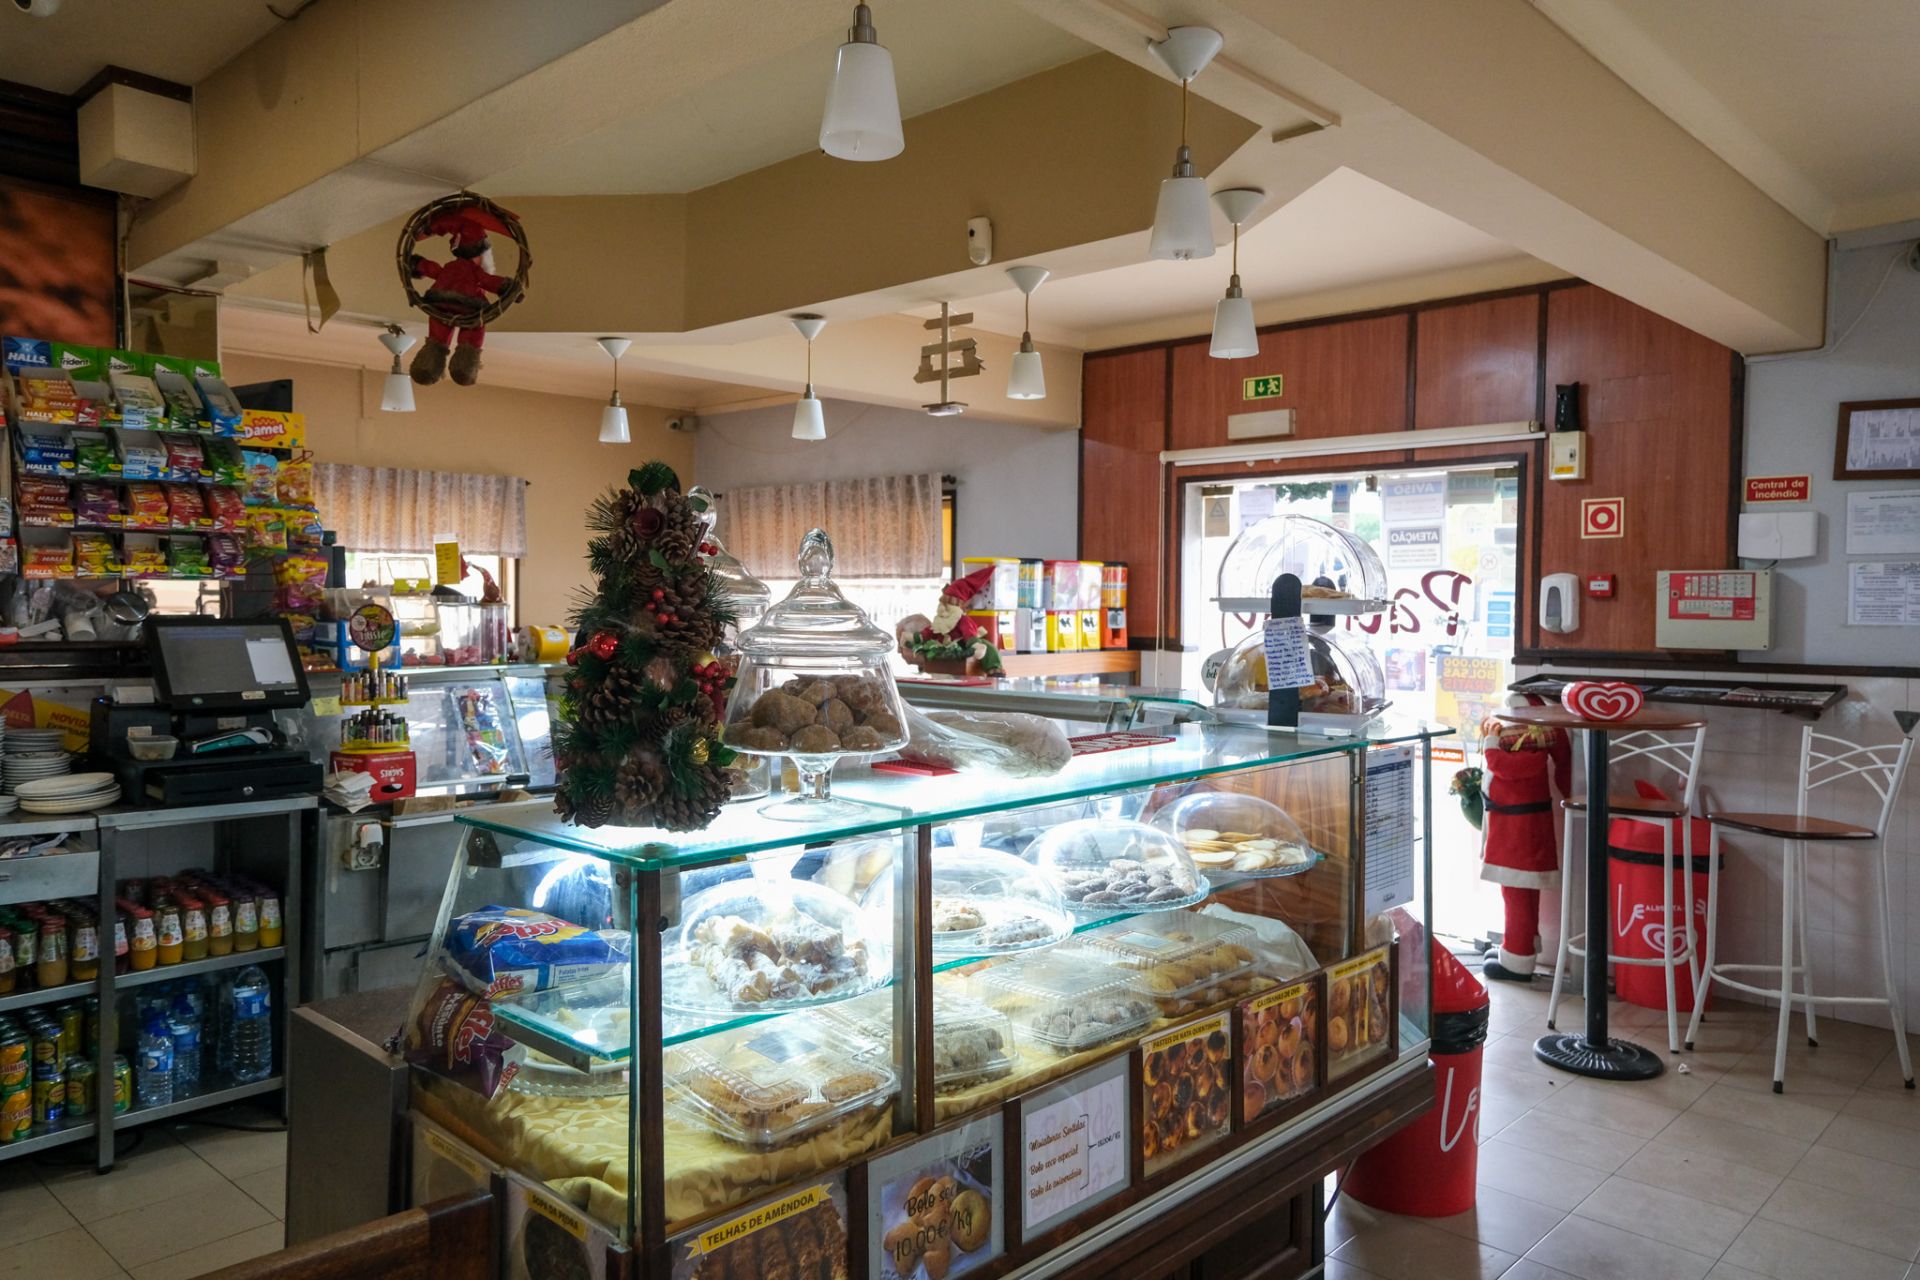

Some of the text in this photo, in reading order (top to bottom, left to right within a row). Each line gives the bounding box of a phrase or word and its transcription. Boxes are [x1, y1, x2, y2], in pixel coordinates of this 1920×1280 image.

[8, 351, 48, 364] HALLS
[59, 357, 90, 367] Trident
[107, 362, 136, 371] Trident
[244, 423, 285, 438] Damel
[42, 451, 70, 459] HALLS
[26, 463, 53, 471] HALLS
[1750, 479, 1805, 490] Central de
[1755, 489, 1800, 499] incêndio
[26, 568, 53, 576] HALLS
[1029, 1161, 1044, 1176] Bolo
[1029, 1184, 1045, 1200] Bolo
[903, 1188, 935, 1217] Bolo
[705, 1192, 816, 1247] TELHAS DE AMÊNDOA
